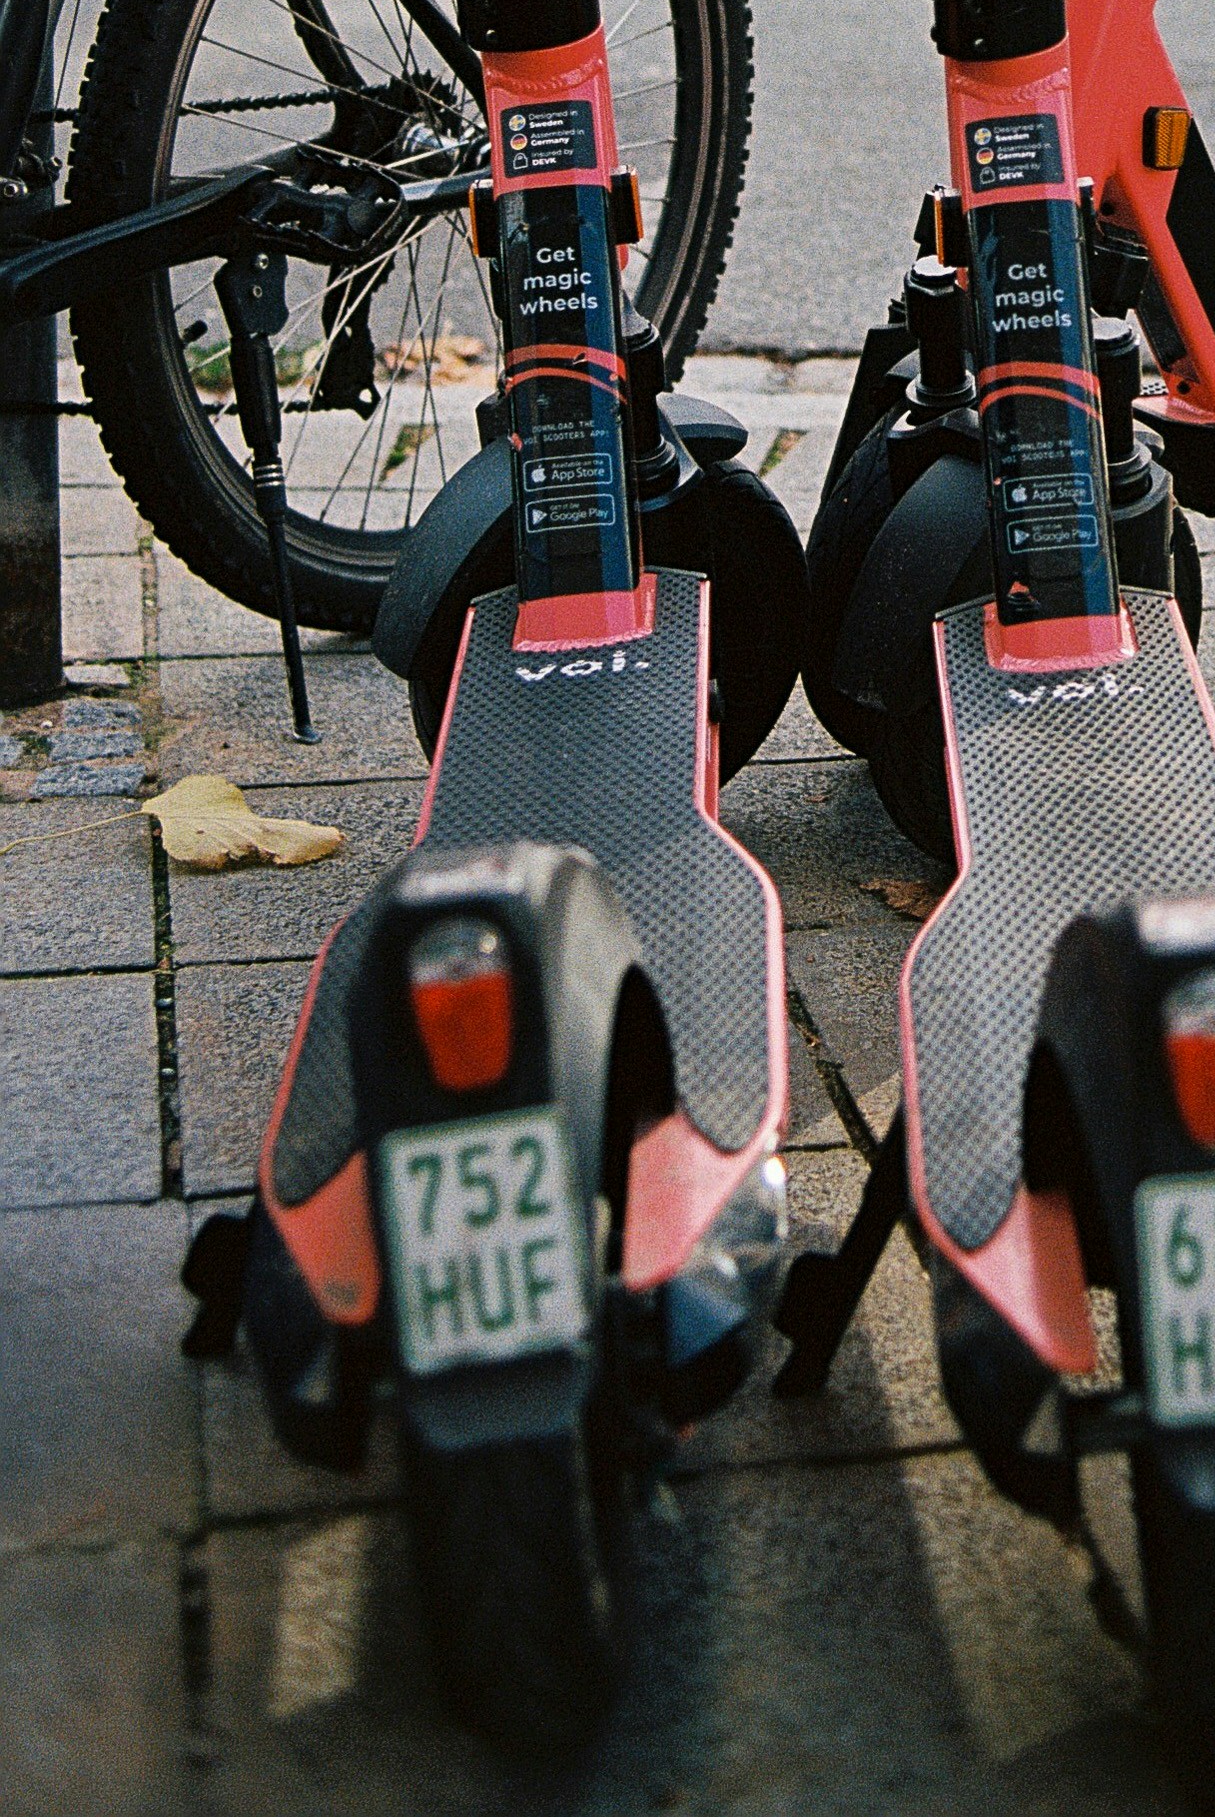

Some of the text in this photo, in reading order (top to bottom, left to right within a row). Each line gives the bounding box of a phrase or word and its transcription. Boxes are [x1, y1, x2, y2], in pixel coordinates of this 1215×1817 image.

[528, 110, 568, 120] Designed
[529, 119, 563, 129] Sweden
[530, 128, 576, 139] Assembled
[530, 137, 570, 147] Germany
[563, 148, 574, 156] by
[997, 152, 1036, 161] Germany
[532, 157, 557, 166] DEVK
[999, 172, 1024, 181] DEVK
[536, 246, 575, 264] Get
[1008, 263, 1048, 281] Get
[523, 268, 592, 291] magic
[995, 285, 1065, 308] magic
[520, 293, 599, 316] wheels
[992, 309, 1072, 333] wheels
[532, 420, 595, 433] DOWNLOAD THE
[543, 431, 585, 442] SCOOTERS
[551, 466, 605, 482] App Store
[1032, 490, 1056, 502] App
[550, 507, 608, 521] Google Play
[1032, 528, 1092, 543] Google Play
[515, 649, 649, 681] voi.
[406, 1135, 552, 1235] 752
[413, 1237, 556, 1337] HUF
